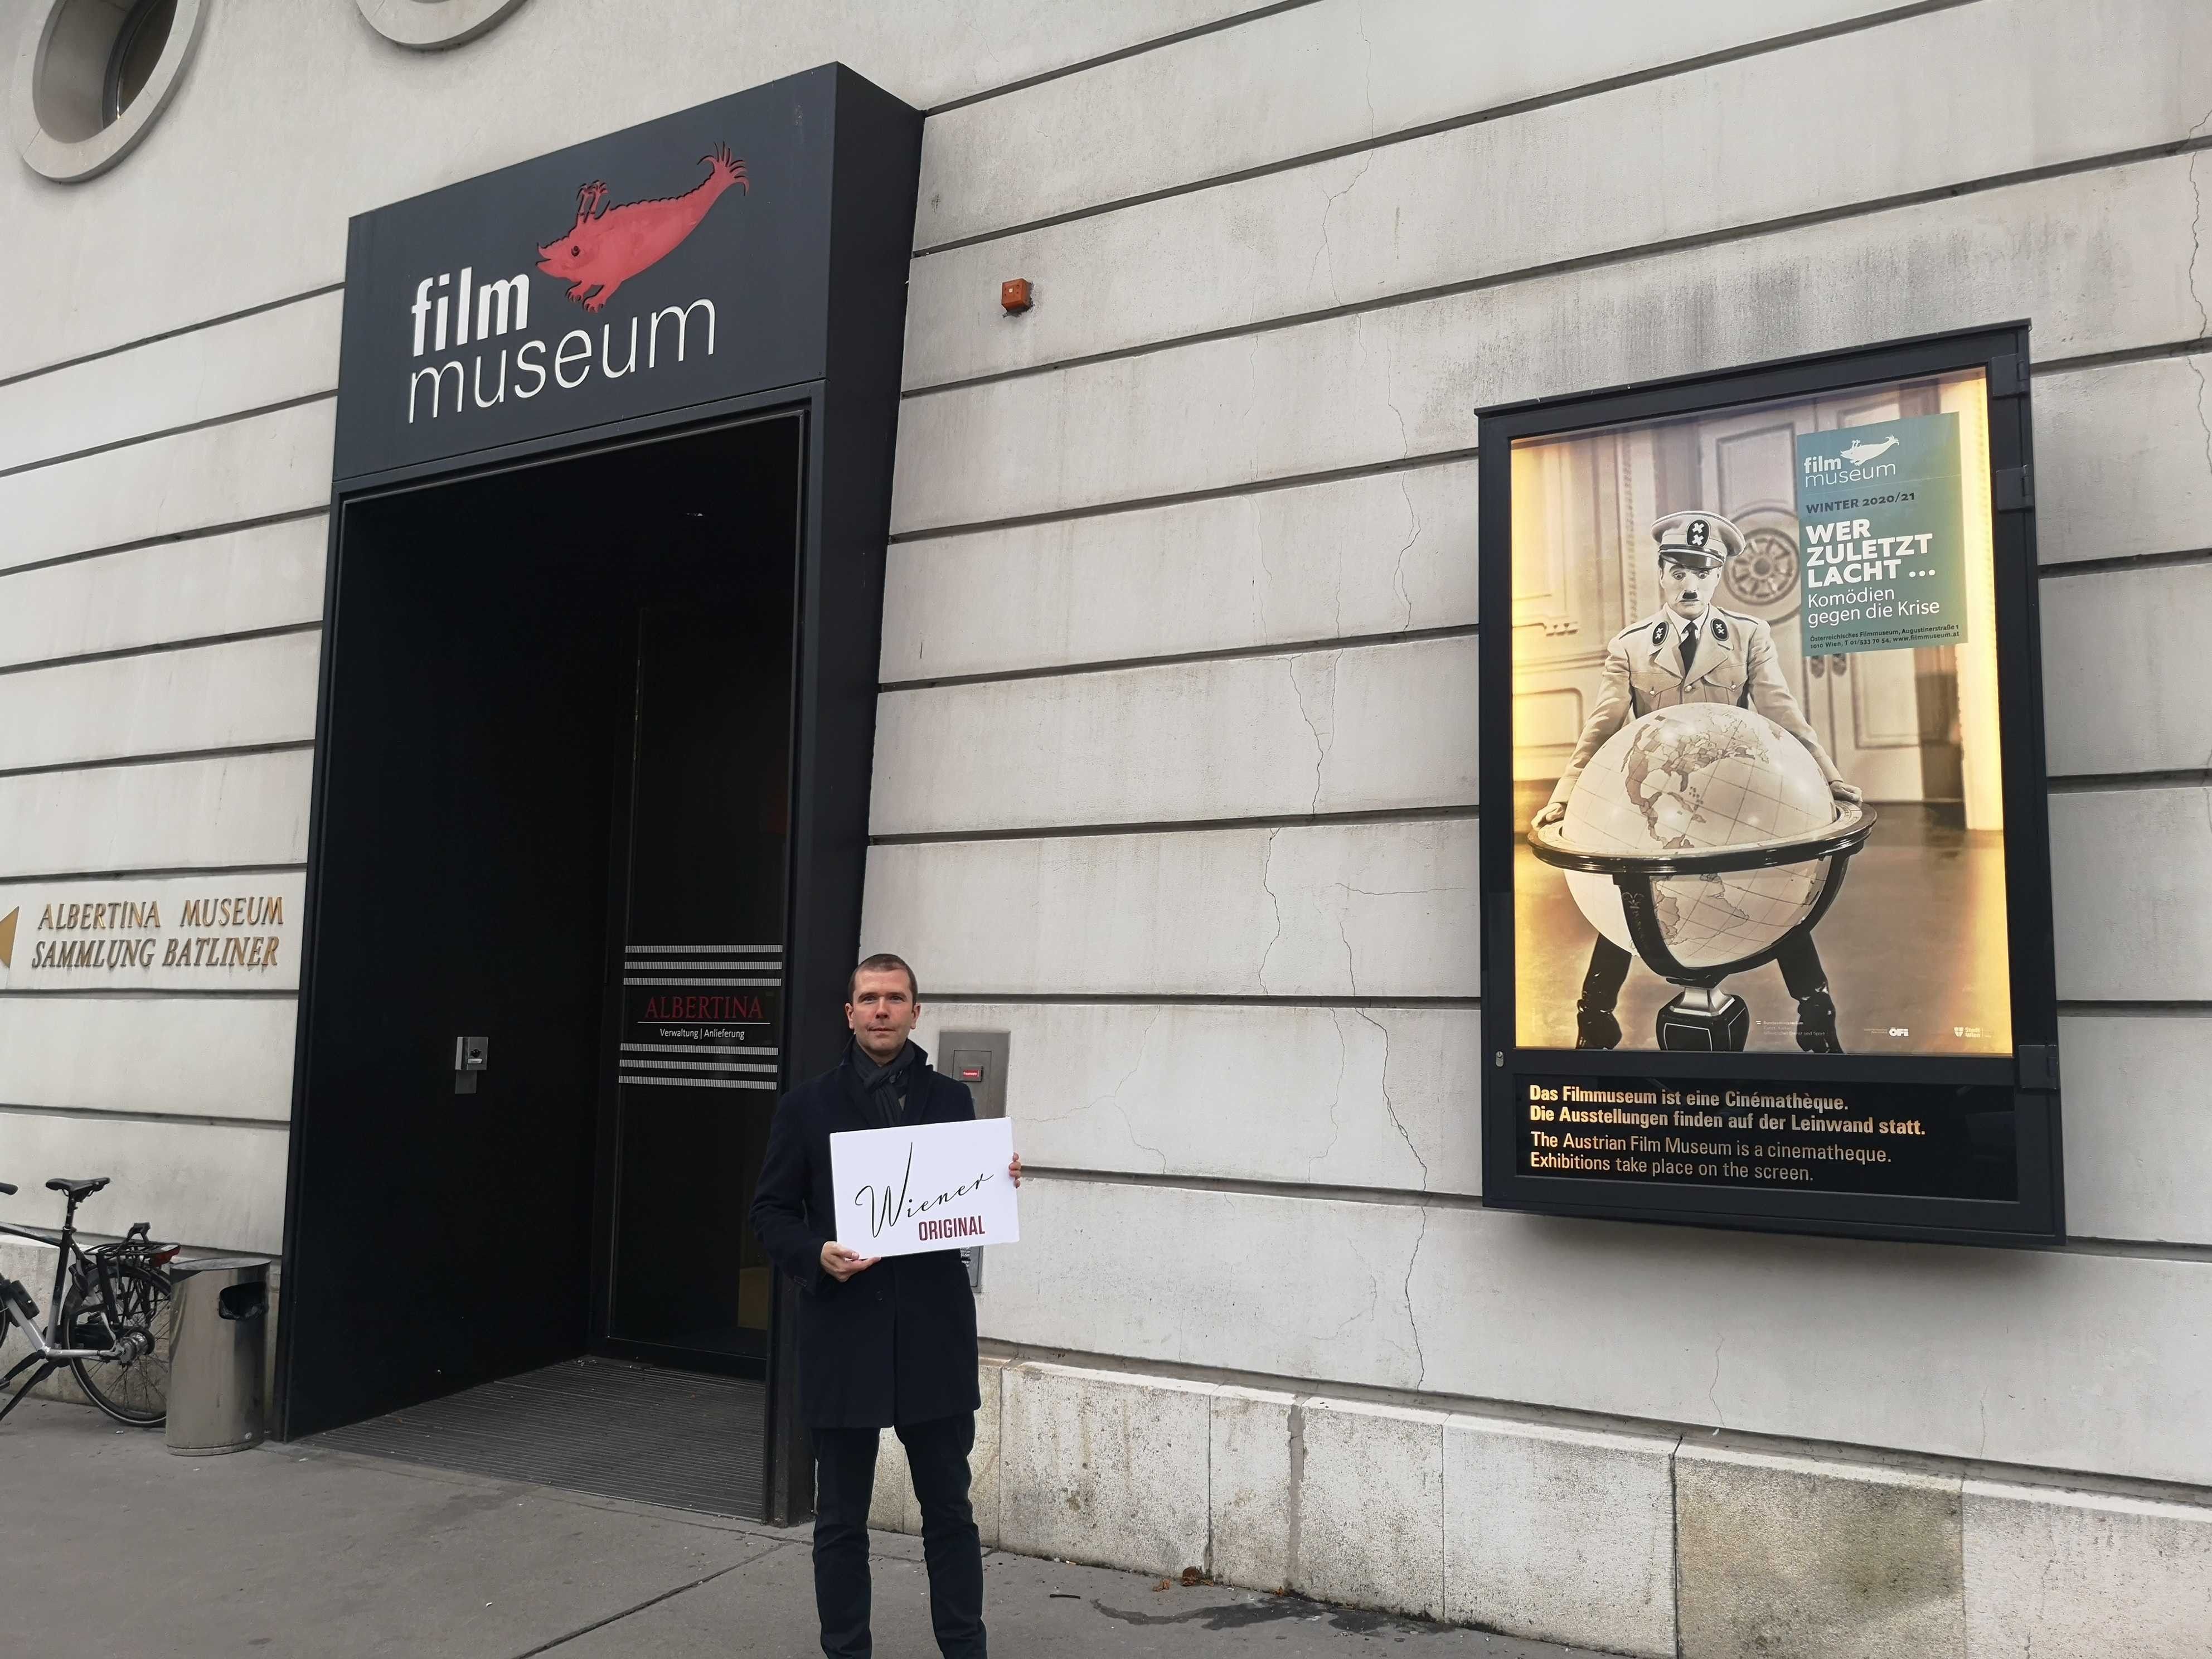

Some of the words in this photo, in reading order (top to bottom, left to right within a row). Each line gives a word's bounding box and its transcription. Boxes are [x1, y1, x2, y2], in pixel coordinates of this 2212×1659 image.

[411, 266, 530, 357] film
[409, 298, 715, 423] museum
[1804, 455, 1841, 474] film
[1806, 463, 1896, 487] museum
[1806, 499, 1859, 514] WINTER
[1862, 492, 1915, 508] 2020/21
[1806, 518, 1870, 545] WER
[1806, 533, 1933, 567] ZULETZT
[1807, 559, 1901, 588] LACHT
[1808, 587, 1894, 608] Komödien
[1808, 605, 1860, 628] gegen
[1866, 603, 1893, 619] die
[1898, 600, 1940, 617] Krise
[1810, 633, 1859, 642] Österreichisches
[1901, 624, 1954, 634] Augustinerstraße
[1893, 631, 1959, 642] www.filmmuseum.at
[38, 901, 161, 930] ALBERTINA
[180, 896, 283, 928] MUSEUM
[32, 937, 156, 969] SAMMLUNG
[162, 936, 280, 967] BATLINER
[644, 996, 763, 1019] ALBERTINA
[660, 1029, 698, 1039] Verwaltung
[704, 1029, 745, 1040] Anlieferung
[1530, 1085, 1558, 1101] Das
[1563, 1086, 1657, 1104] Filmmuseum
[1662, 1089, 1681, 1105] ist
[1686, 1090, 1720, 1106] eine
[1725, 1091, 1848, 1114] Cinémathèque.
[1530, 1105, 1554, 1121] Die
[1559, 1107, 1668, 1128] Ausstellungen
[1673, 1110, 1723, 1128] finden
[1728, 1113, 1754, 1129] auf
[1759, 1114, 1786, 1130] der
[1791, 1114, 1874, 1133] Leinwand
[1879, 1119, 1925, 1135] statt.
[1530, 1131, 1558, 1148] The
[1563, 1133, 1626, 1151] Austrian
[1631, 1136, 1661, 1152] Film
[1665, 1137, 1731, 1155] Museum
[1736, 1140, 1749, 1156] is
[1754, 1144, 1763, 1157] a
[1768, 1142, 1891, 1165] cinematheque.
[1530, 1152, 1611, 1170] Exhibitions
[1616, 1157, 1647, 1172] take
[1652, 1158, 1694, 1177] place
[1699, 1163, 1718, 1176] on
[1723, 1162, 1749, 1177] the
[1754, 1165, 1813, 1181] screen.
[855, 1142, 995, 1238] Wiener
[918, 1215, 986, 1241] ORIGINAL
